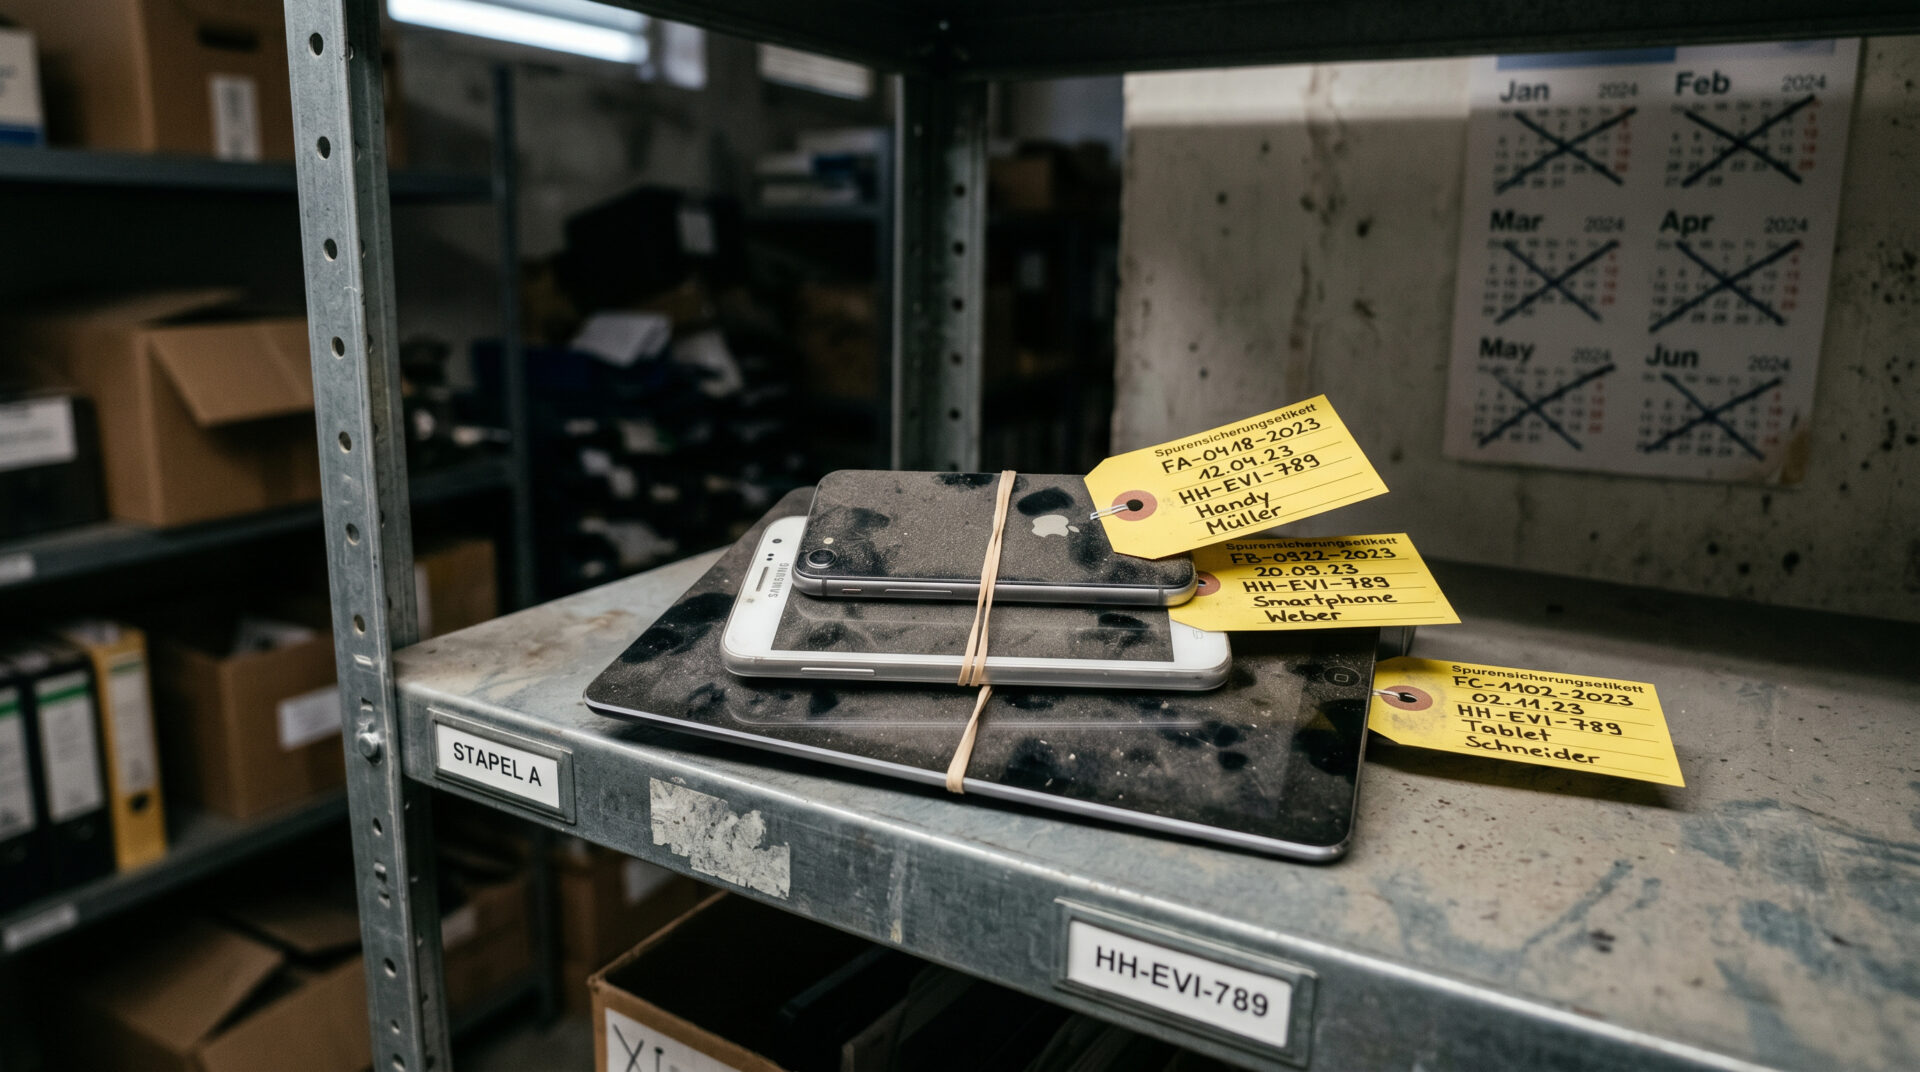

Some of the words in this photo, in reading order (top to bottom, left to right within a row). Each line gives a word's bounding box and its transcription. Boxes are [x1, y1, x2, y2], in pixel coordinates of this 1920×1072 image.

[1501, 80, 1550, 102] Jan
[1598, 81, 1640, 99] 2024
[1675, 72, 1732, 96] Feb
[1781, 75, 1827, 93] 2024
[1490, 210, 1544, 232] Mar
[1584, 215, 1626, 233] 2024
[1659, 210, 1715, 237] Apr
[1764, 216, 1809, 233] 2024
[1479, 336, 1535, 363] May
[1572, 348, 1612, 364] 2024
[1645, 345, 1699, 368] Jun
[1748, 356, 1791, 373] 2024
[1154, 403, 1318, 458] Spurensicherungsetikett
[1161, 417, 1321, 473] FA-0418-2023
[1198, 445, 1294, 480] 12.04.23
[1178, 453, 1320, 504] HH-EVI-789
[1195, 491, 1270, 519] Handy
[1205, 504, 1282, 535] Müller
[1230, 548, 1396, 565] FB-0922-2023
[768, 562, 790, 598] SAMSUNG
[1256, 564, 1359, 577] 20.09.23
[1243, 577, 1390, 593] HH-EVI-789
[1253, 593, 1398, 609] Smartphone
[1264, 610, 1342, 623] Weber
[1452, 665, 1645, 694] Spurensicherungsetikett
[1453, 676, 1634, 707] FC-1102-2023
[1471, 692, 1585, 715] 02.11.23
[1458, 704, 1623, 735] HH-EVI-789
[1461, 719, 1552, 742] Tablet
[1465, 735, 1601, 764] Schneider
[453, 742, 523, 781] STAPEL
[528, 766, 542, 787] A
[1096, 946, 1269, 1017] HH-EVI-789
